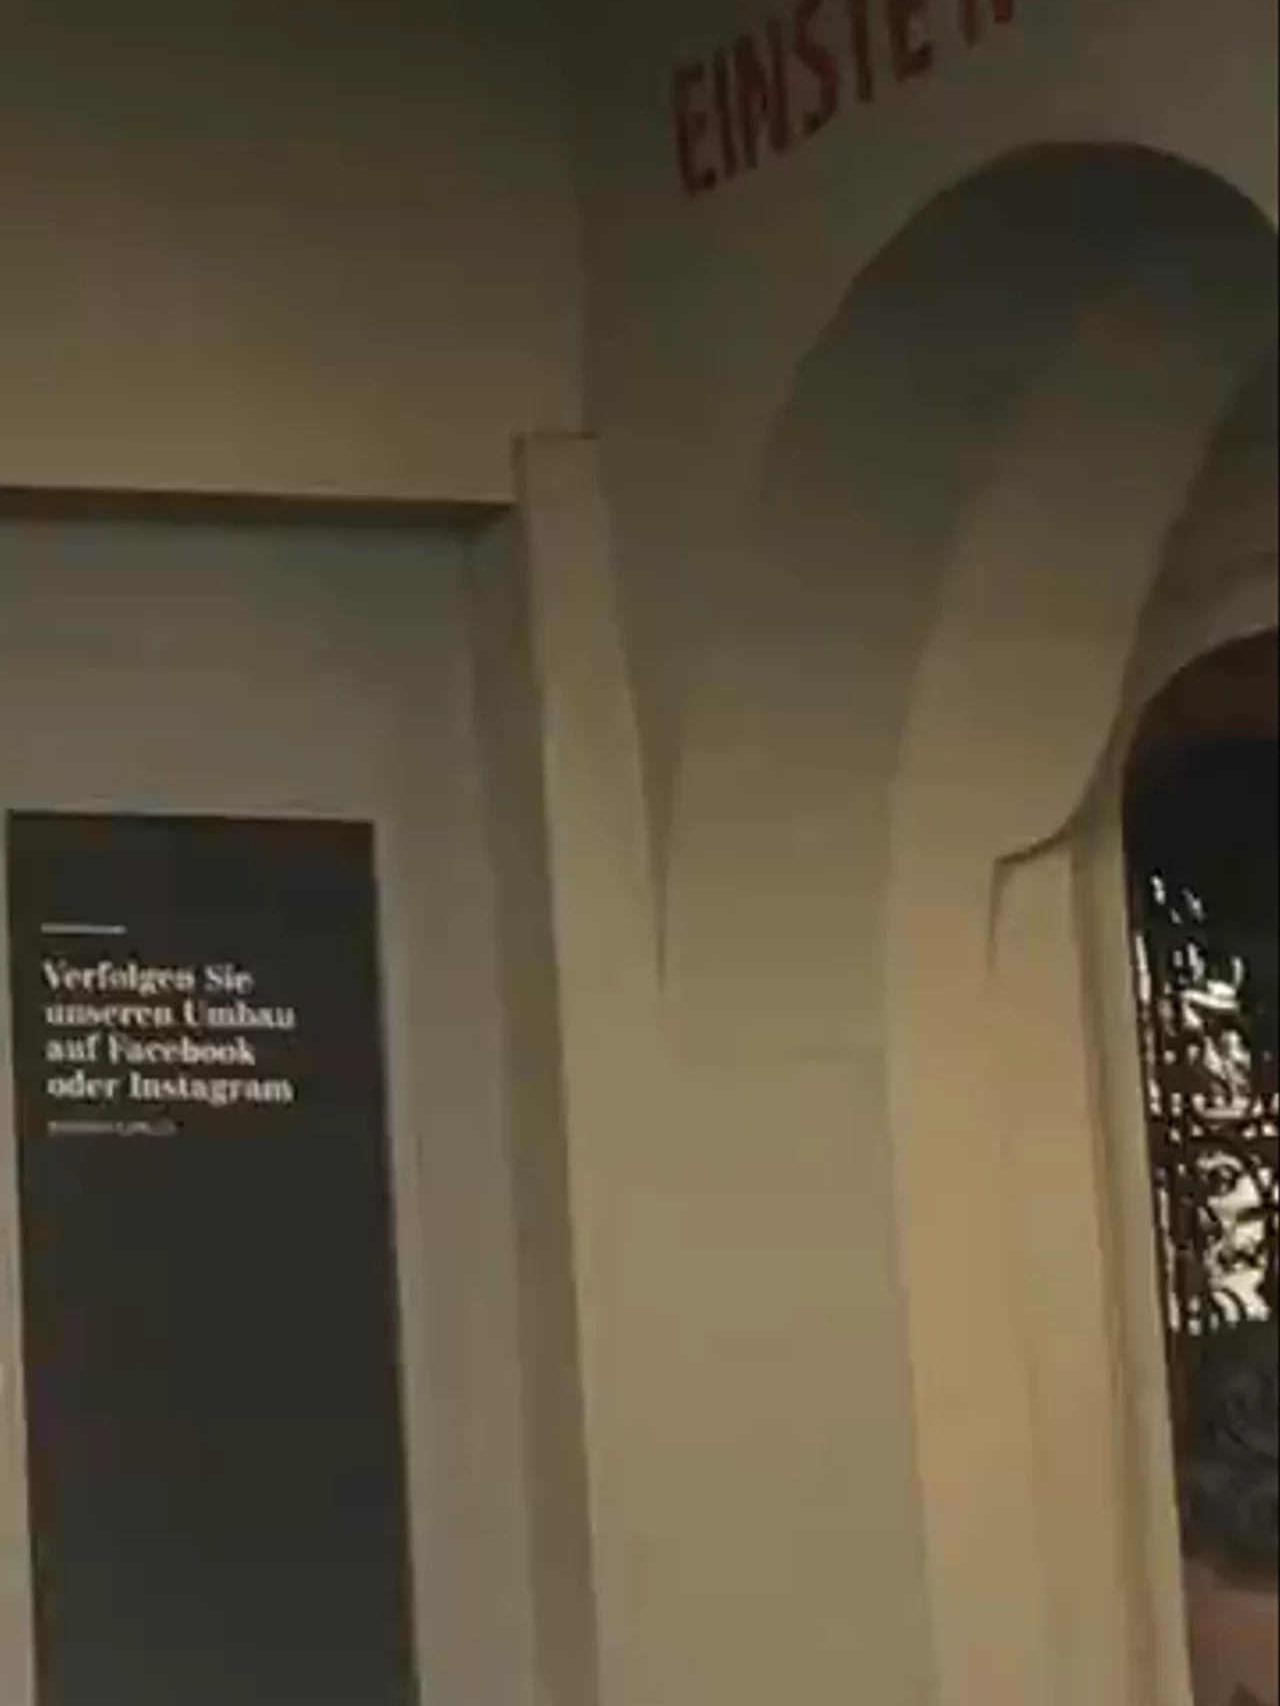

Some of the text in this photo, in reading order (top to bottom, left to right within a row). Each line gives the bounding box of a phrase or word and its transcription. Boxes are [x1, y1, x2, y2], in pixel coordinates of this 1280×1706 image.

[42, 959, 255, 996] Verfolgen Sie
[45, 1000, 296, 1030] unseren Umbau
[45, 1033, 256, 1066] auf Facebook
[47, 1069, 295, 1107] oder Instagram
